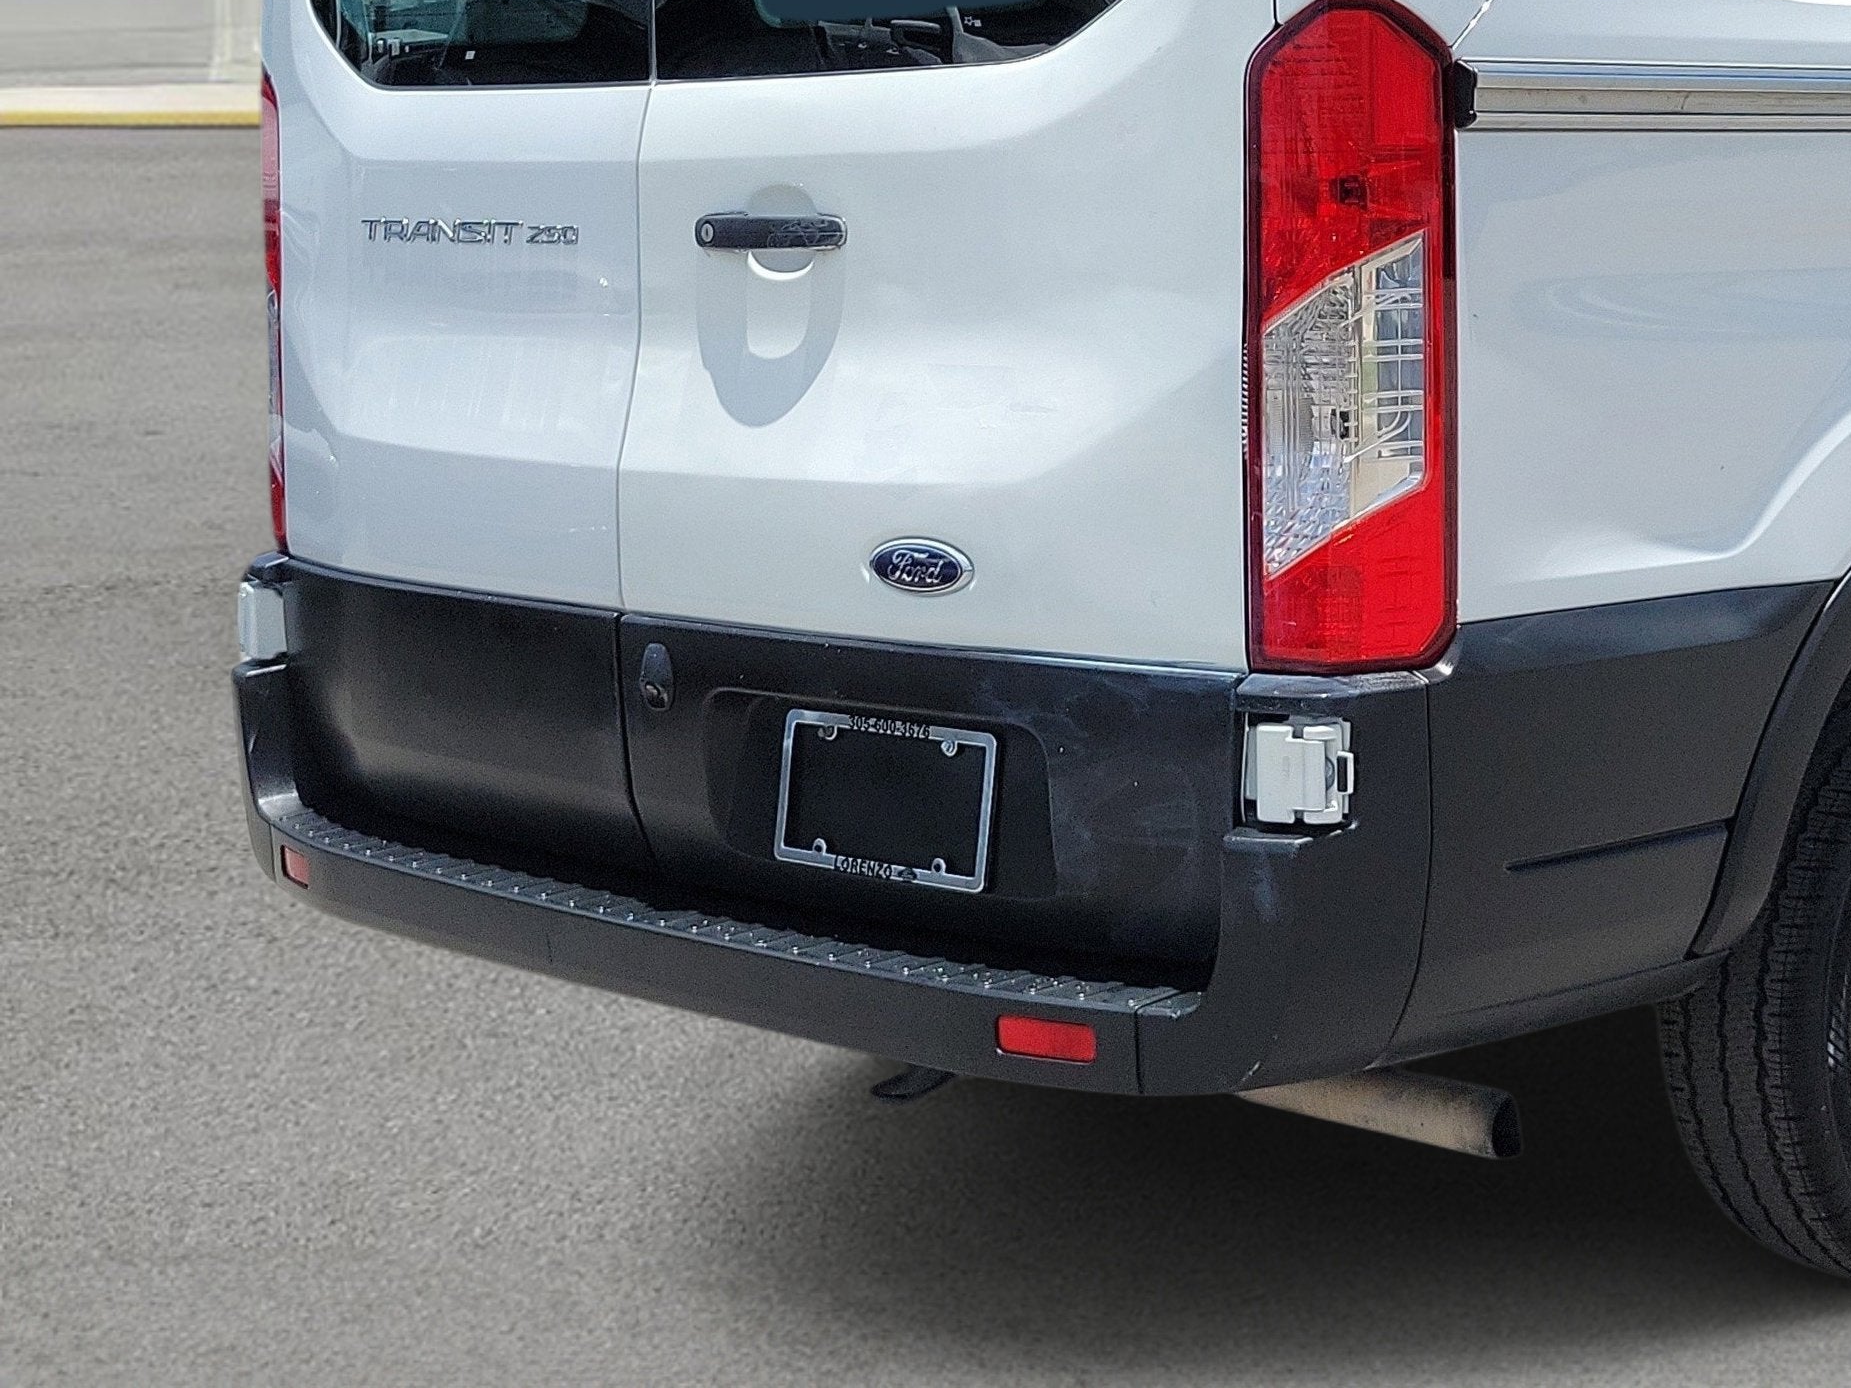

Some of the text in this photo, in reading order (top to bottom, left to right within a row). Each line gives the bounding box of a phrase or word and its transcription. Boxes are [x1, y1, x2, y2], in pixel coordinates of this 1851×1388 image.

[361, 216, 579, 245] TRANSIT 250
[887, 549, 945, 583] Ford
[833, 854, 893, 880] LORENZO
